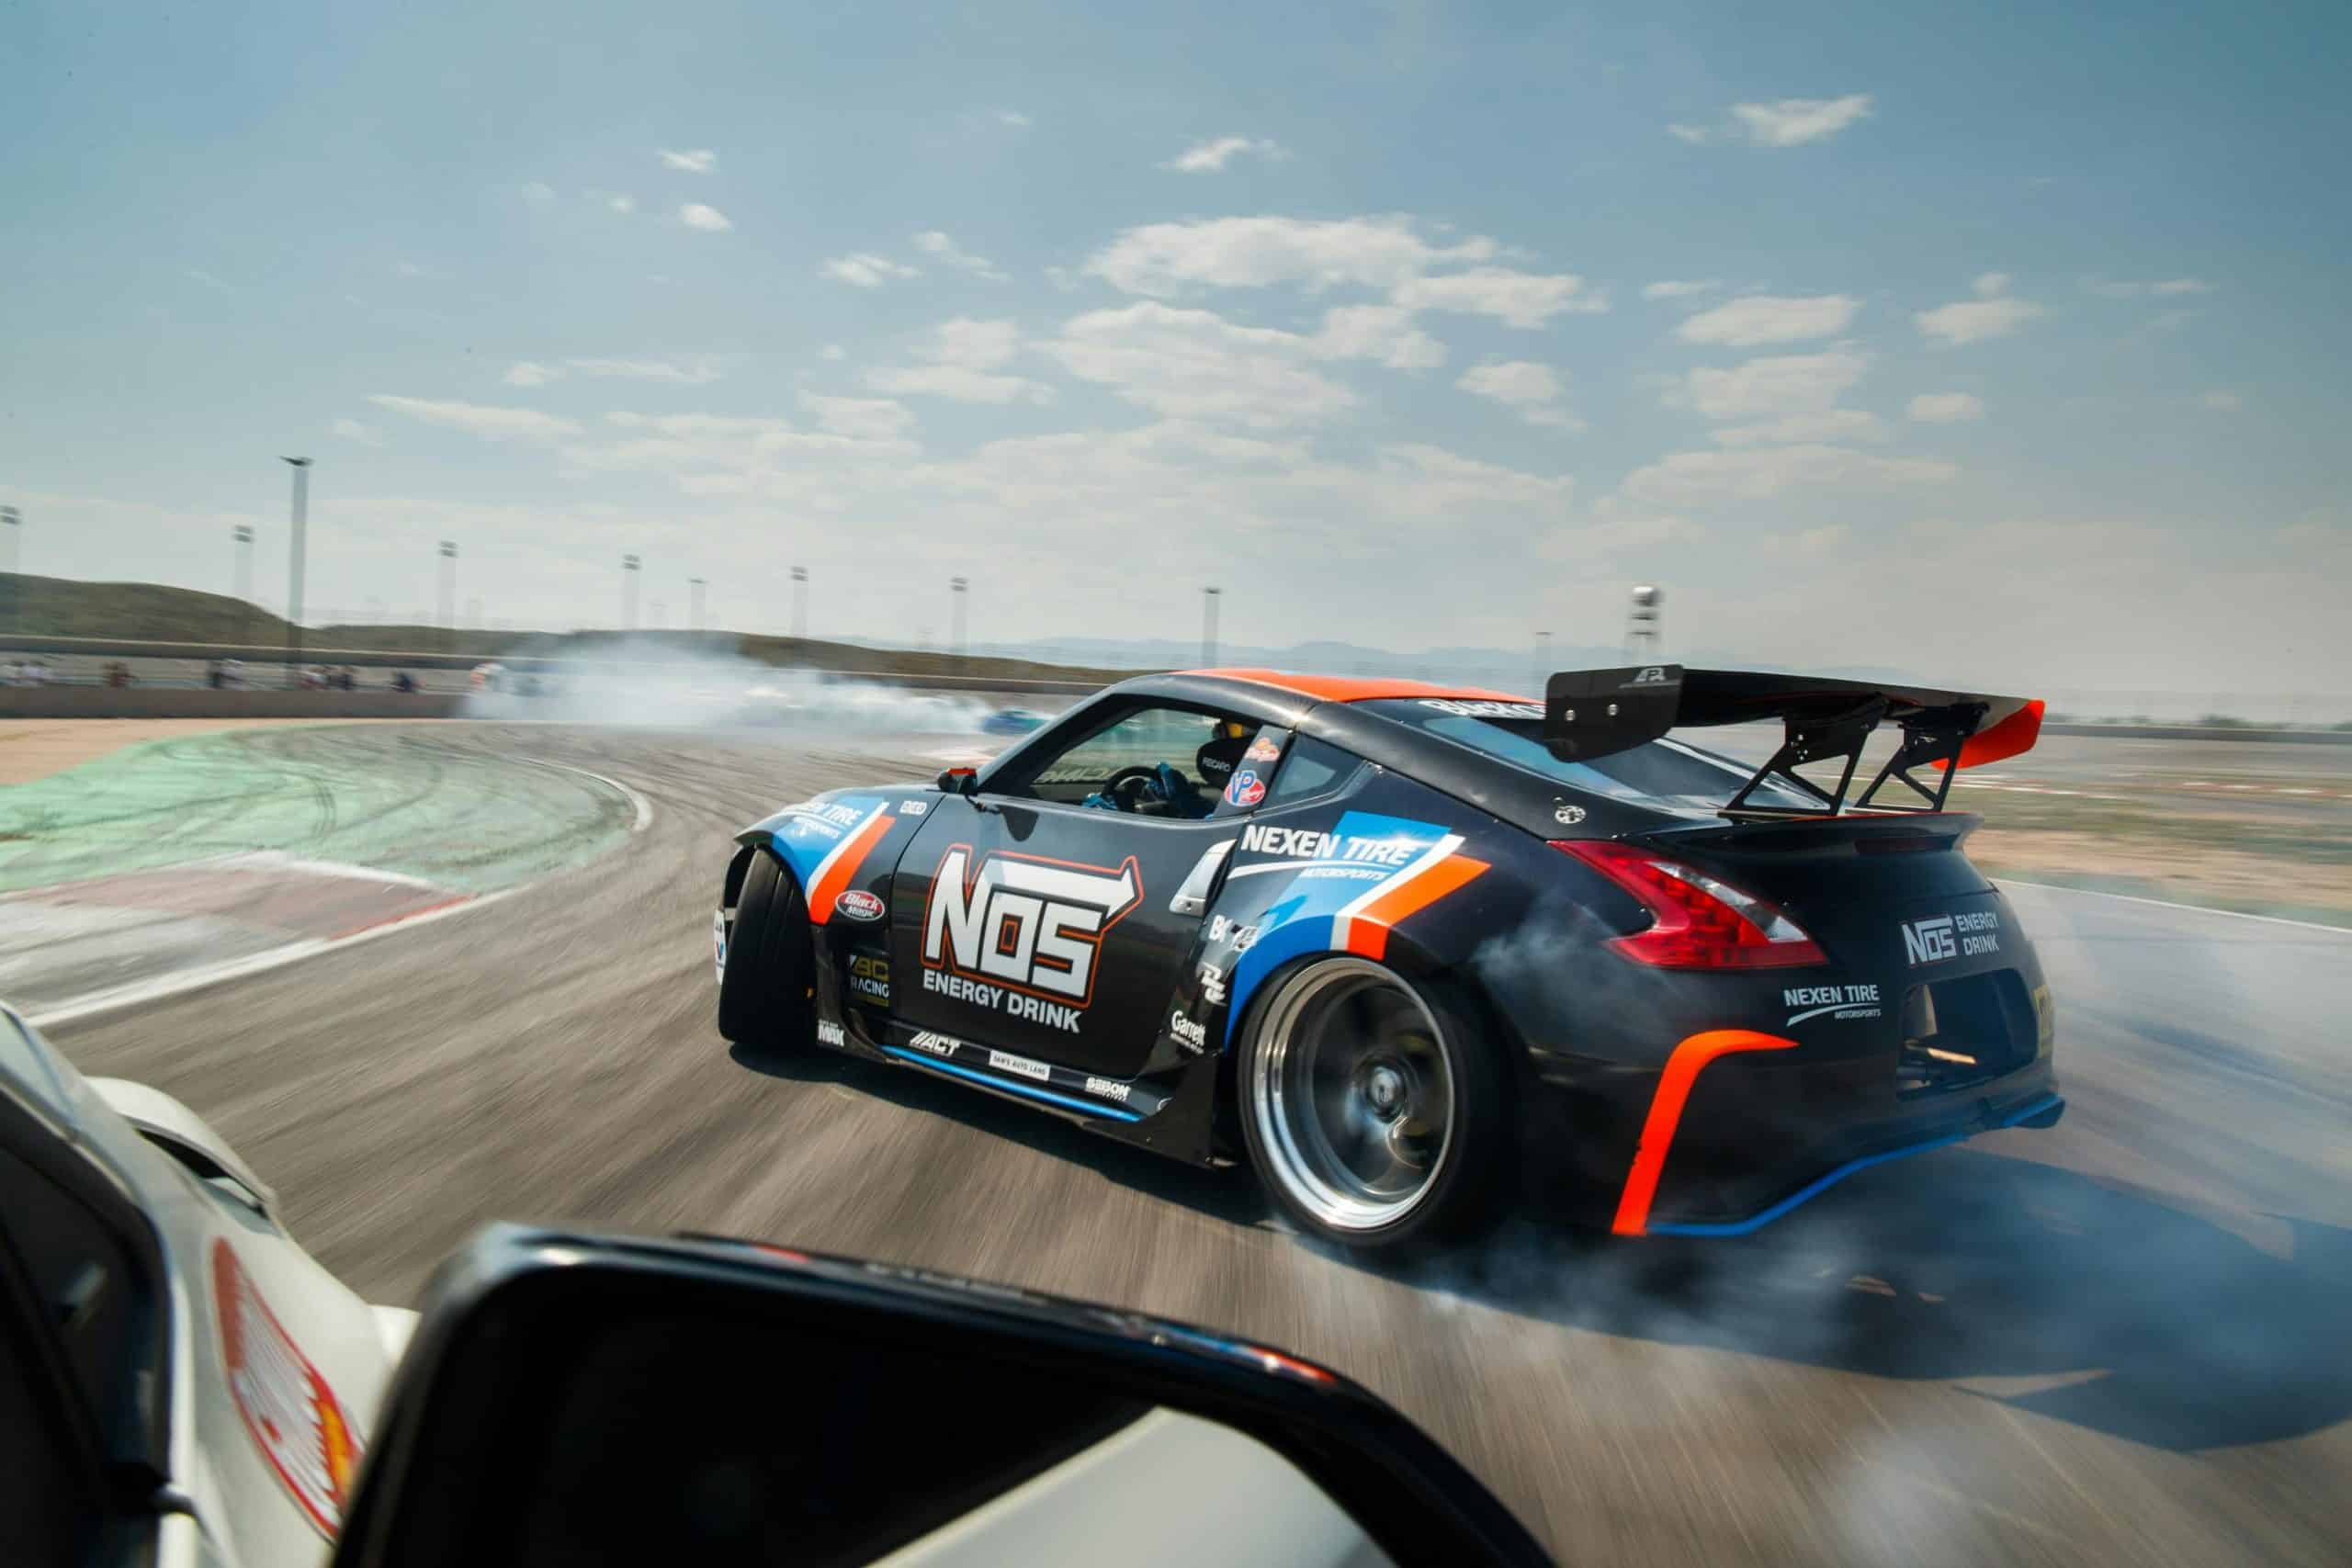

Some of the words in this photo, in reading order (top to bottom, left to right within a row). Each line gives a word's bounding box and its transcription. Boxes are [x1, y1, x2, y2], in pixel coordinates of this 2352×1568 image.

[1241, 825, 1341, 858] NEXEN
[1342, 837, 1418, 865] TIRE
[924, 849, 1137, 999] NOS
[1955, 911, 1999, 932] ENERGY
[1901, 916, 1957, 964] NOS
[1962, 934, 1999, 955] DRINK
[851, 976, 889, 998] RACING
[922, 968, 1007, 1009] ENERGY
[1007, 992, 1082, 1032] DRINK
[1783, 986, 1842, 1006] NEXEN
[1845, 984, 1880, 1002] TIRE
[1171, 1010, 1206, 1046] Garrett
